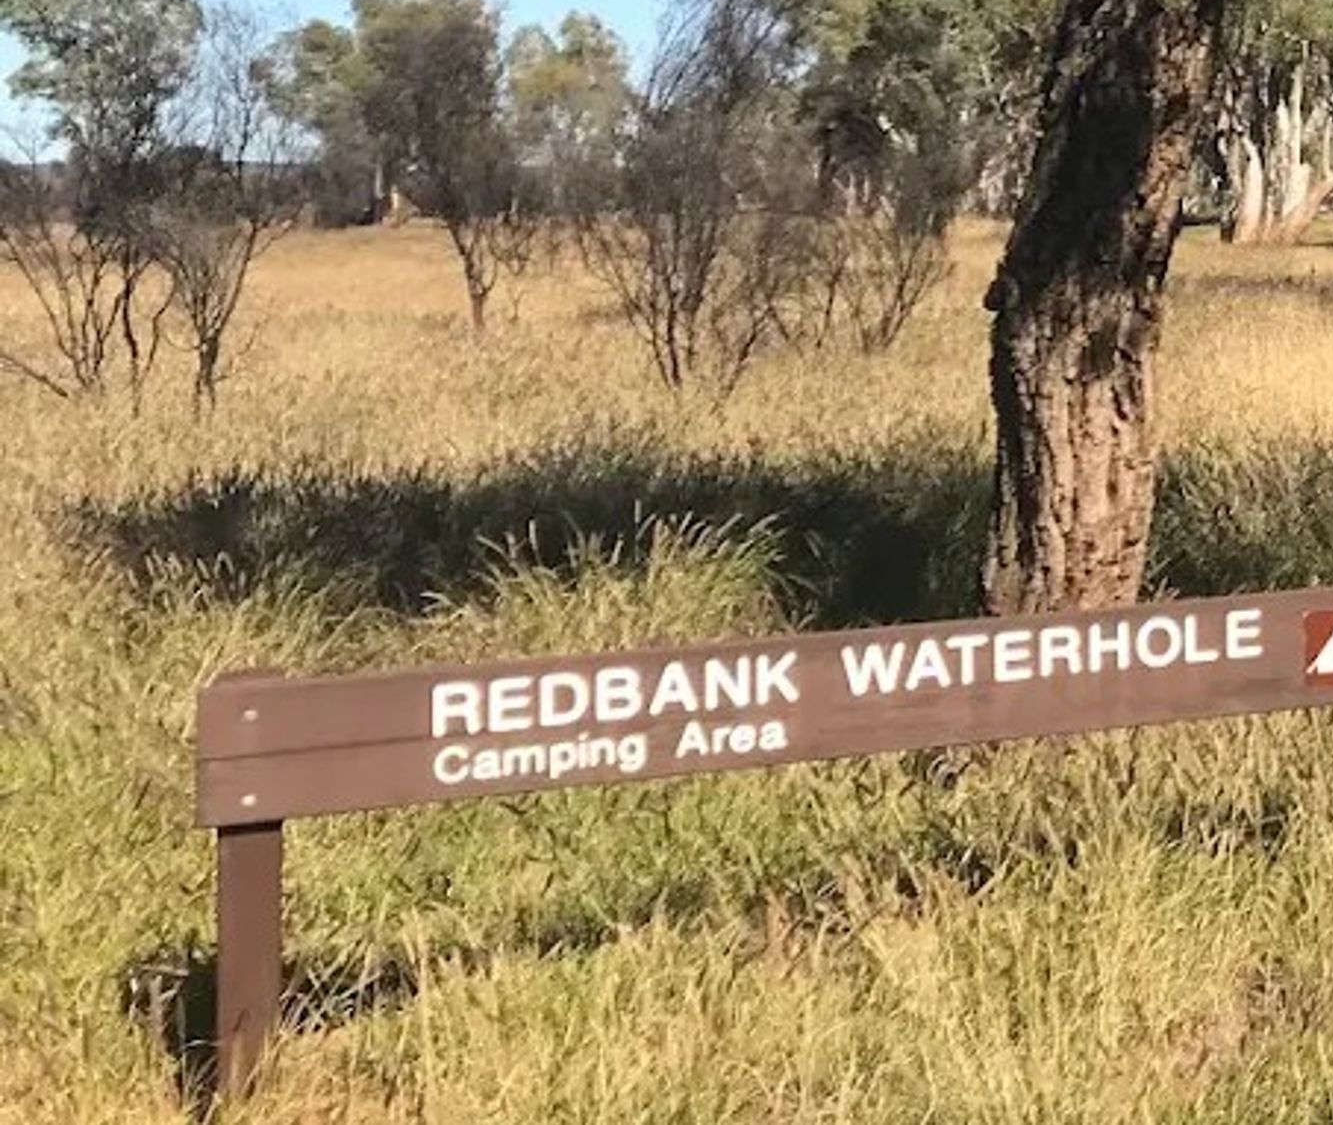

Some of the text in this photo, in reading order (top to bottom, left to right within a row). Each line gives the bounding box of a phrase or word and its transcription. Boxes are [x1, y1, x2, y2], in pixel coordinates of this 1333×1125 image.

[431, 608, 1263, 737] REDBANK WATERHOLE
[432, 719, 788, 784] Camping Area
